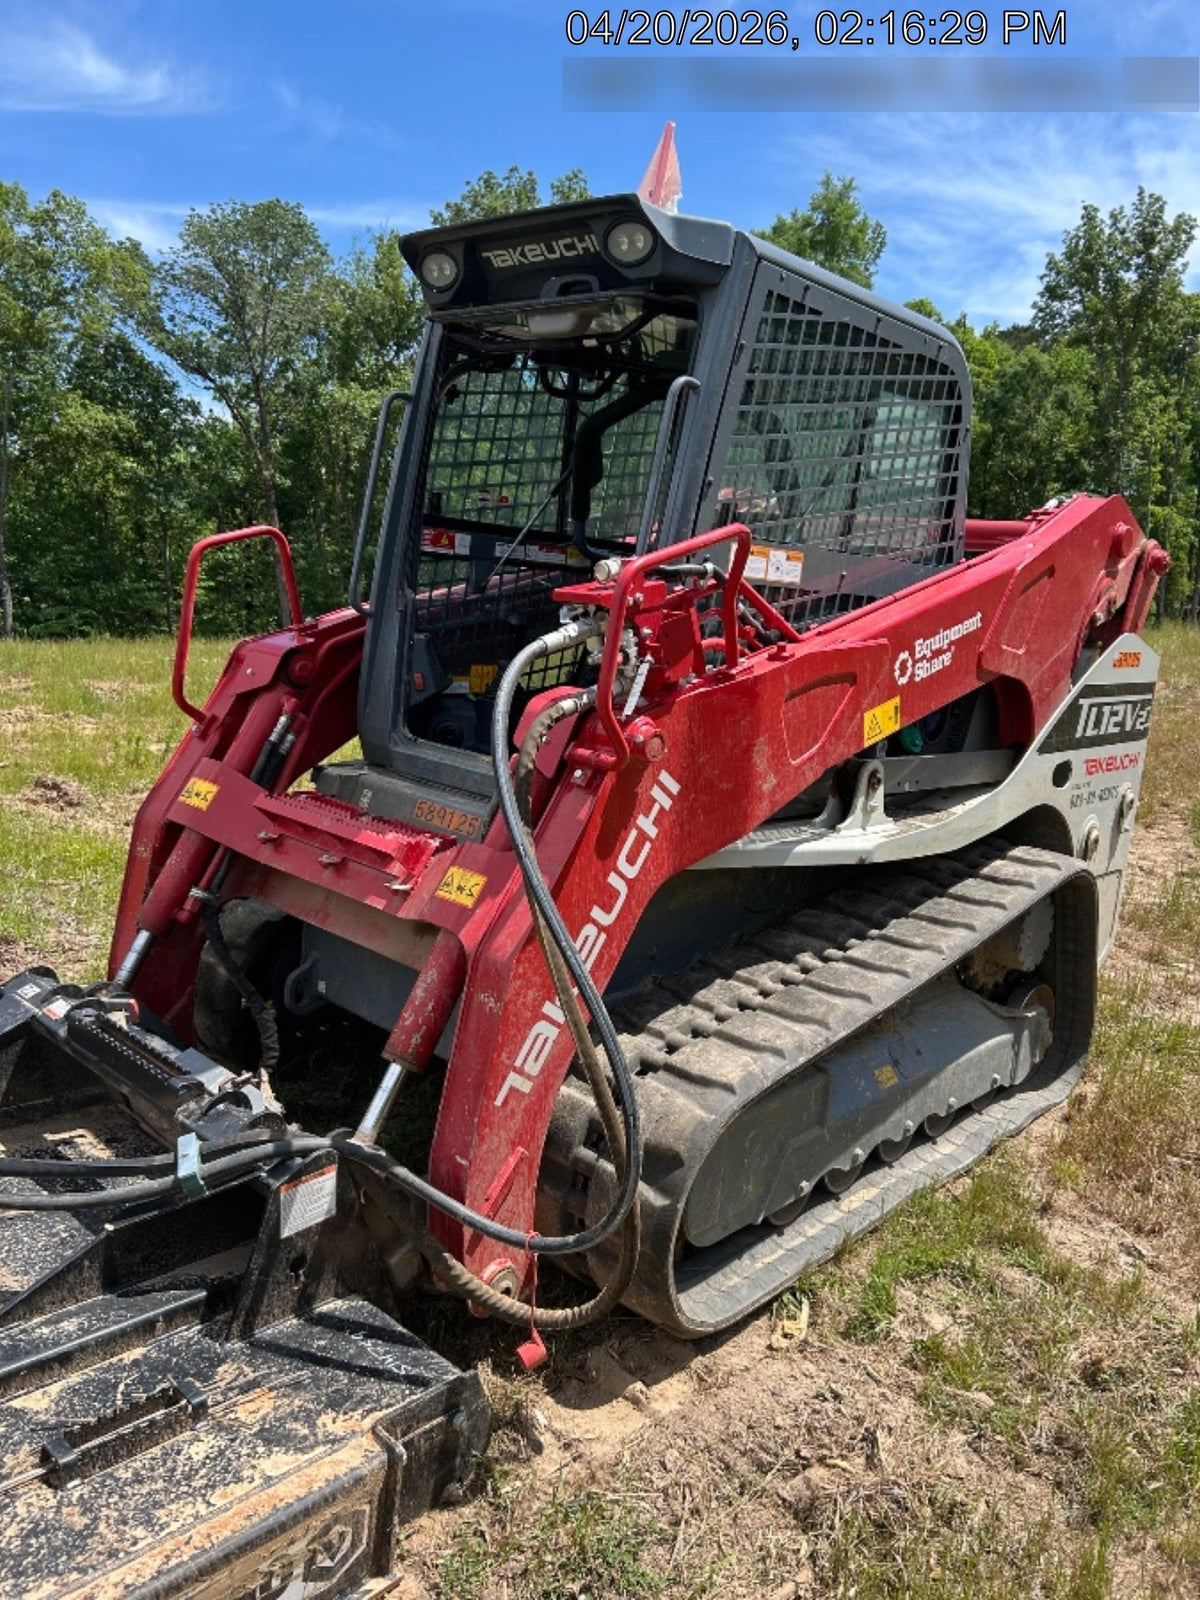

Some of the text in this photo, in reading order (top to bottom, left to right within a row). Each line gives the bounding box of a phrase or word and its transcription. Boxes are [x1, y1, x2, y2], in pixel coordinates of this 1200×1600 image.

[481, 233, 600, 268] TAKEUCHI
[914, 608, 982, 658] Equipment
[914, 650, 952, 682] Share
